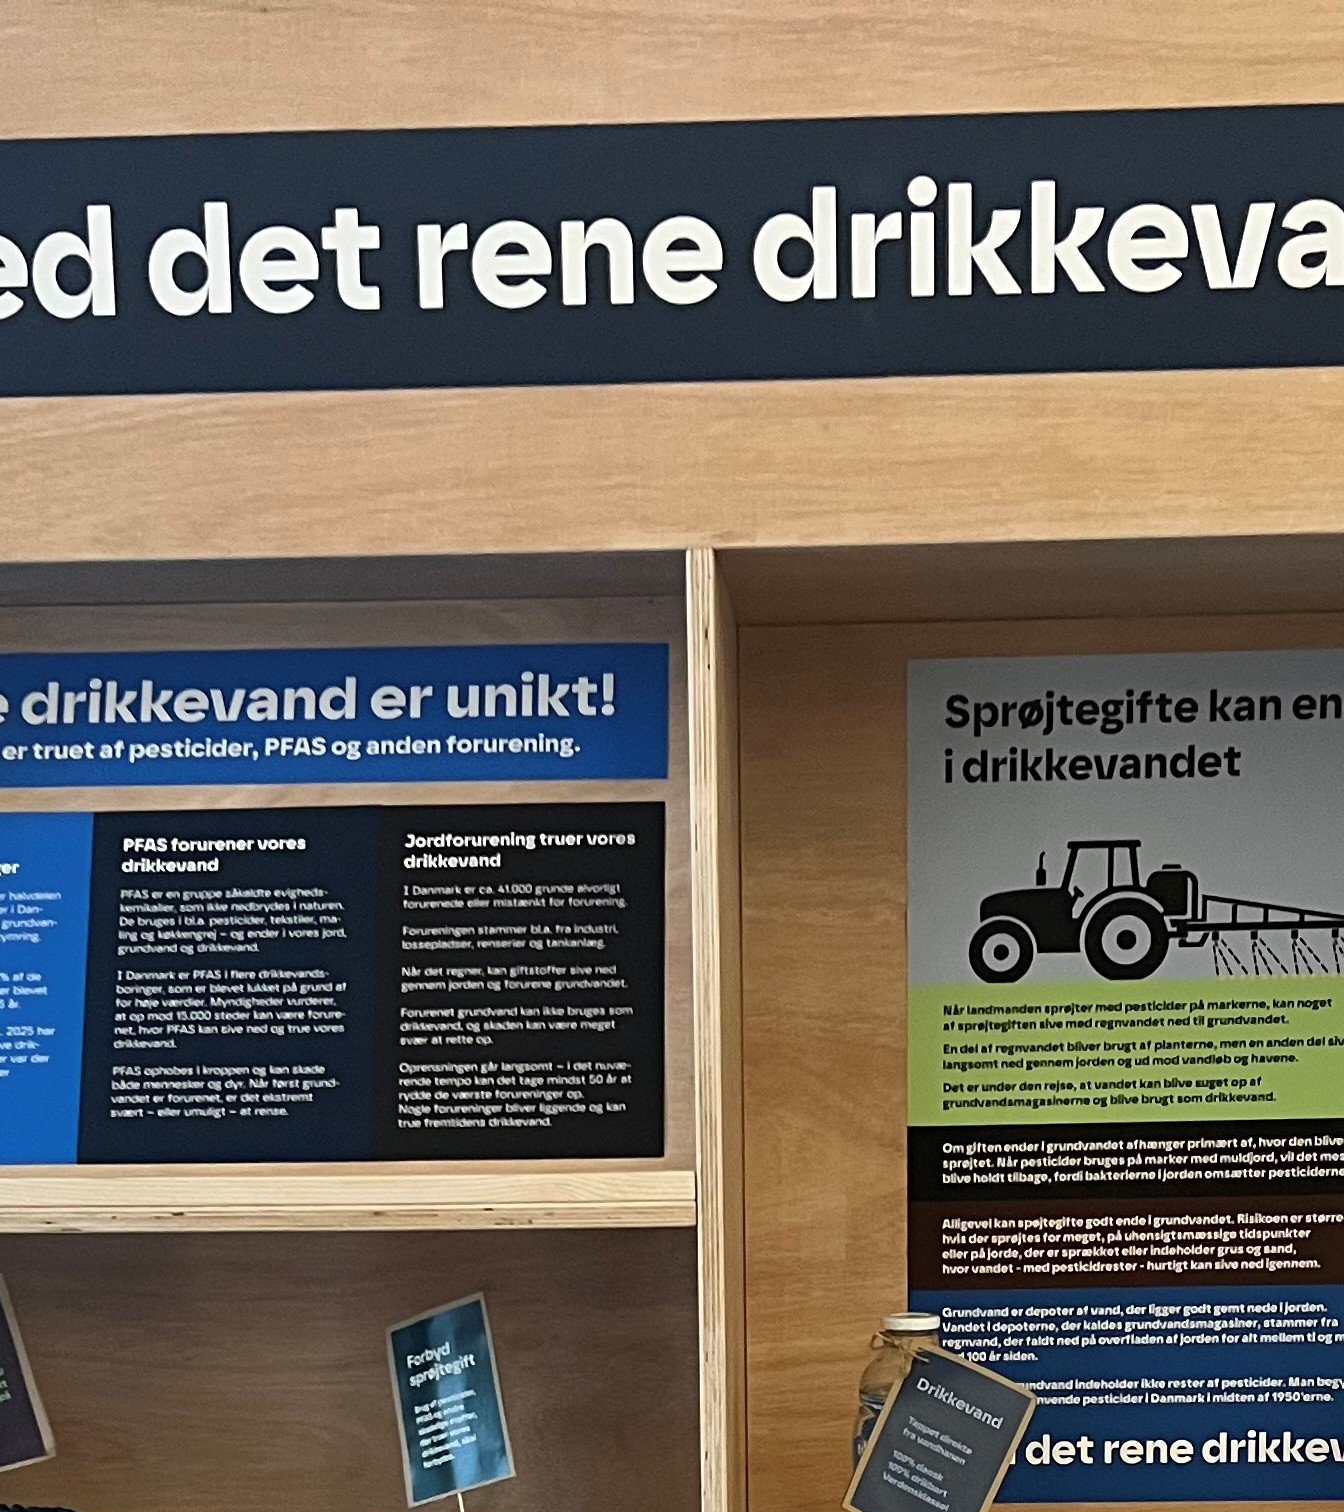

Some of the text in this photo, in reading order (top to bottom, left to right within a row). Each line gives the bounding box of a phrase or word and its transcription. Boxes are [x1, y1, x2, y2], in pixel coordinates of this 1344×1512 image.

[148, 201, 381, 316] det
[417, 215, 724, 309] rene
[21, 676, 357, 725] drikkevand
[370, 685, 433, 720] er
[447, 671, 615, 719] unikt!
[945, 688, 1199, 738] Sprøjtegifte
[1209, 688, 1282, 723] kan
[1, 745, 29, 761] er
[32, 741, 95, 760] truet
[99, 740, 125, 759] af
[128, 737, 259, 764] pesticider,
[264, 736, 327, 757] PFAS
[331, 740, 362, 761] og
[365, 735, 441, 756] anden
[445, 732, 581, 758] forurening.
[962, 744, 1242, 784] drikkevandet
[123, 837, 307, 852] PFAS forurener vores
[404, 831, 636, 850] Jordforurening truer vores
[121, 857, 220, 873] drikkevand
[403, 852, 502, 869] drikkevand
[943, 998, 1333, 1017] Når landmanden sprøjter med pesticider på markerne, kan noget
[406, 1340, 454, 1370] Forbyd
[409, 1353, 479, 1388] sprøjtegift
[916, 1376, 1004, 1430] Drikkevand
[1025, 1433, 1094, 1465] det
[1104, 1439, 1194, 1465] rene
